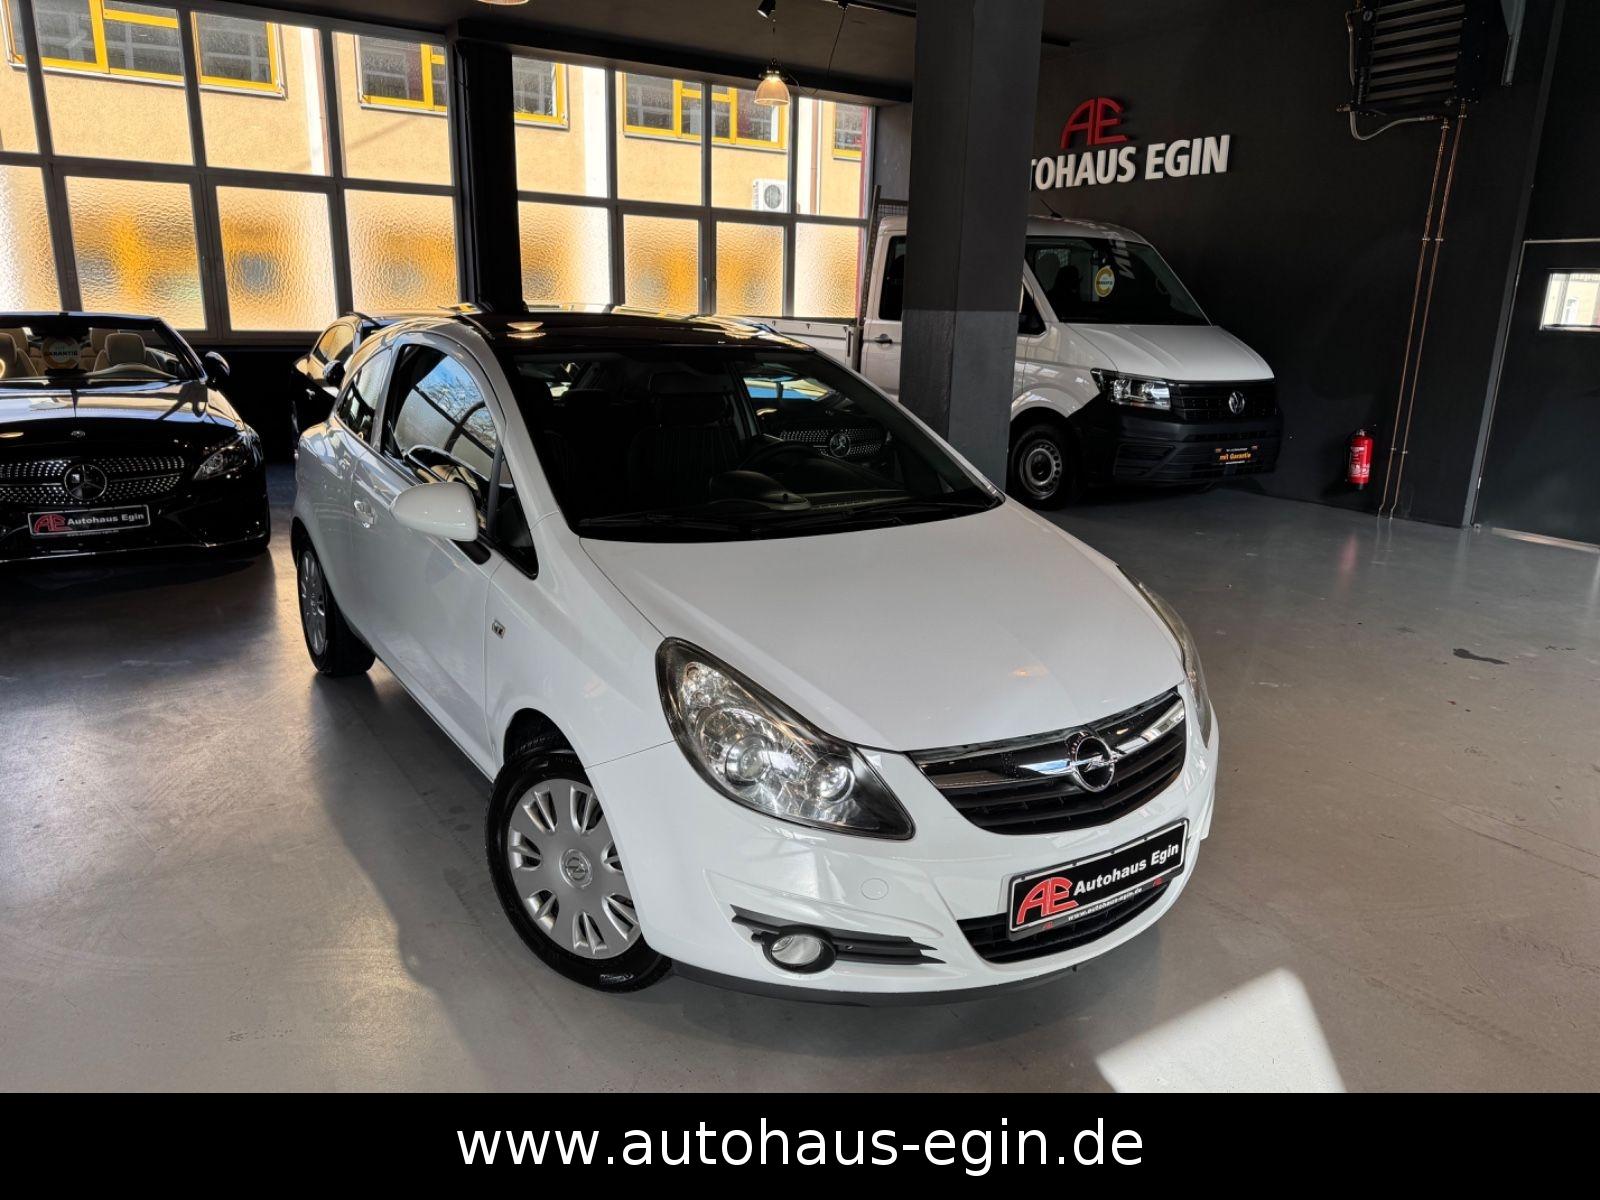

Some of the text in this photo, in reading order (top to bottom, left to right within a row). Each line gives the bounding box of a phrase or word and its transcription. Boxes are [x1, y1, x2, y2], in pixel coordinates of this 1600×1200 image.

[1145, 134, 1230, 180] EGIN
[67, 515, 118, 526] Autohaus
[121, 511, 145, 522] Egin
[1073, 859, 1147, 896] Autohaus
[1150, 843, 1179, 868] Egin
